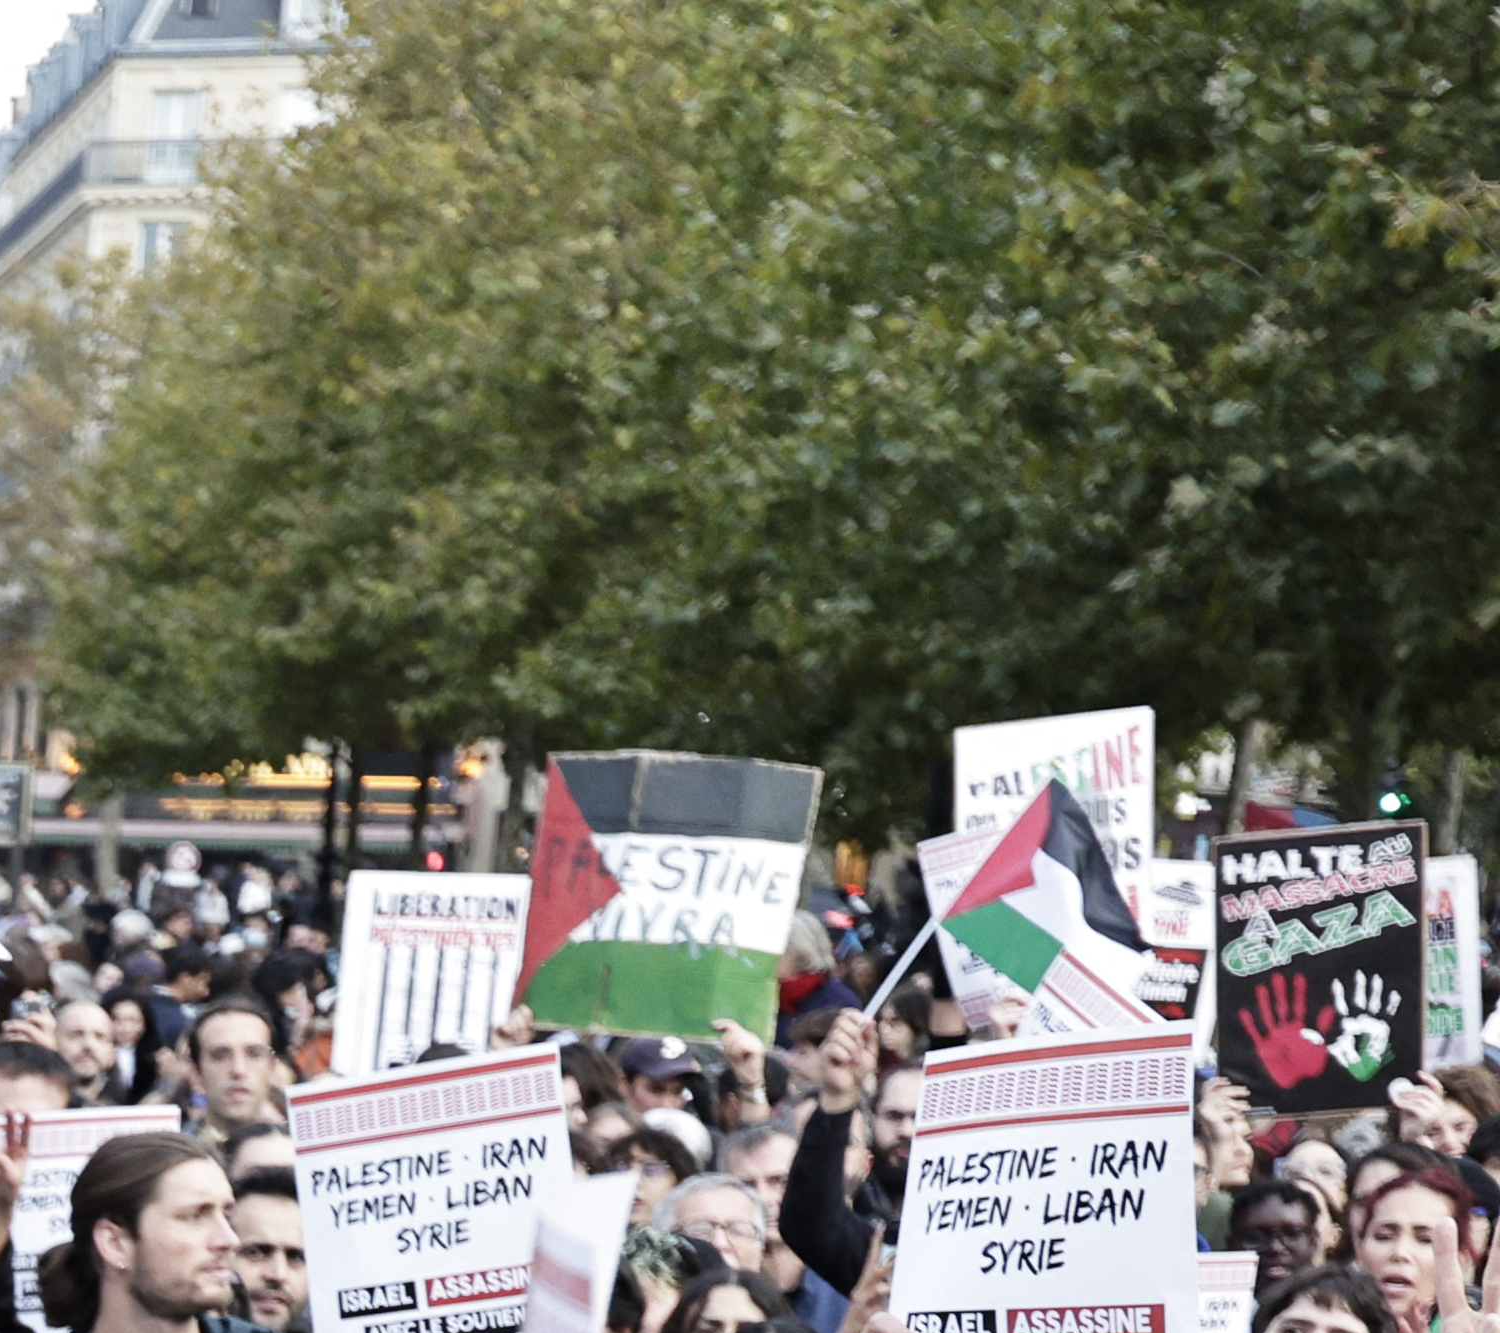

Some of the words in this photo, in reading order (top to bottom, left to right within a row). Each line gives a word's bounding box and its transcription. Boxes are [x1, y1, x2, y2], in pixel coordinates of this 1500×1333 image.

[1221, 844, 1364, 885] HALTE
[1368, 833, 1413, 864] AU
[1221, 856, 1418, 922] MASSACRE
[1221, 890, 1417, 976] GAZA
[311, 1150, 452, 1197] PALESTINE
[481, 1135, 548, 1171] IRAN
[920, 1147, 1058, 1192] PALESTINE
[1090, 1140, 1167, 1178] IRAN
[330, 1192, 417, 1228] YEMEN
[447, 1174, 533, 1210] LIBAN
[926, 1194, 1011, 1234] YEMEN
[1042, 1188, 1145, 1227] LIBAN
[397, 1219, 471, 1253] SYRIE
[980, 1238, 1066, 1275] SYRIE
[342, 1287, 414, 1313] ISRAEL
[429, 1270, 531, 1301] ASSASSIN
